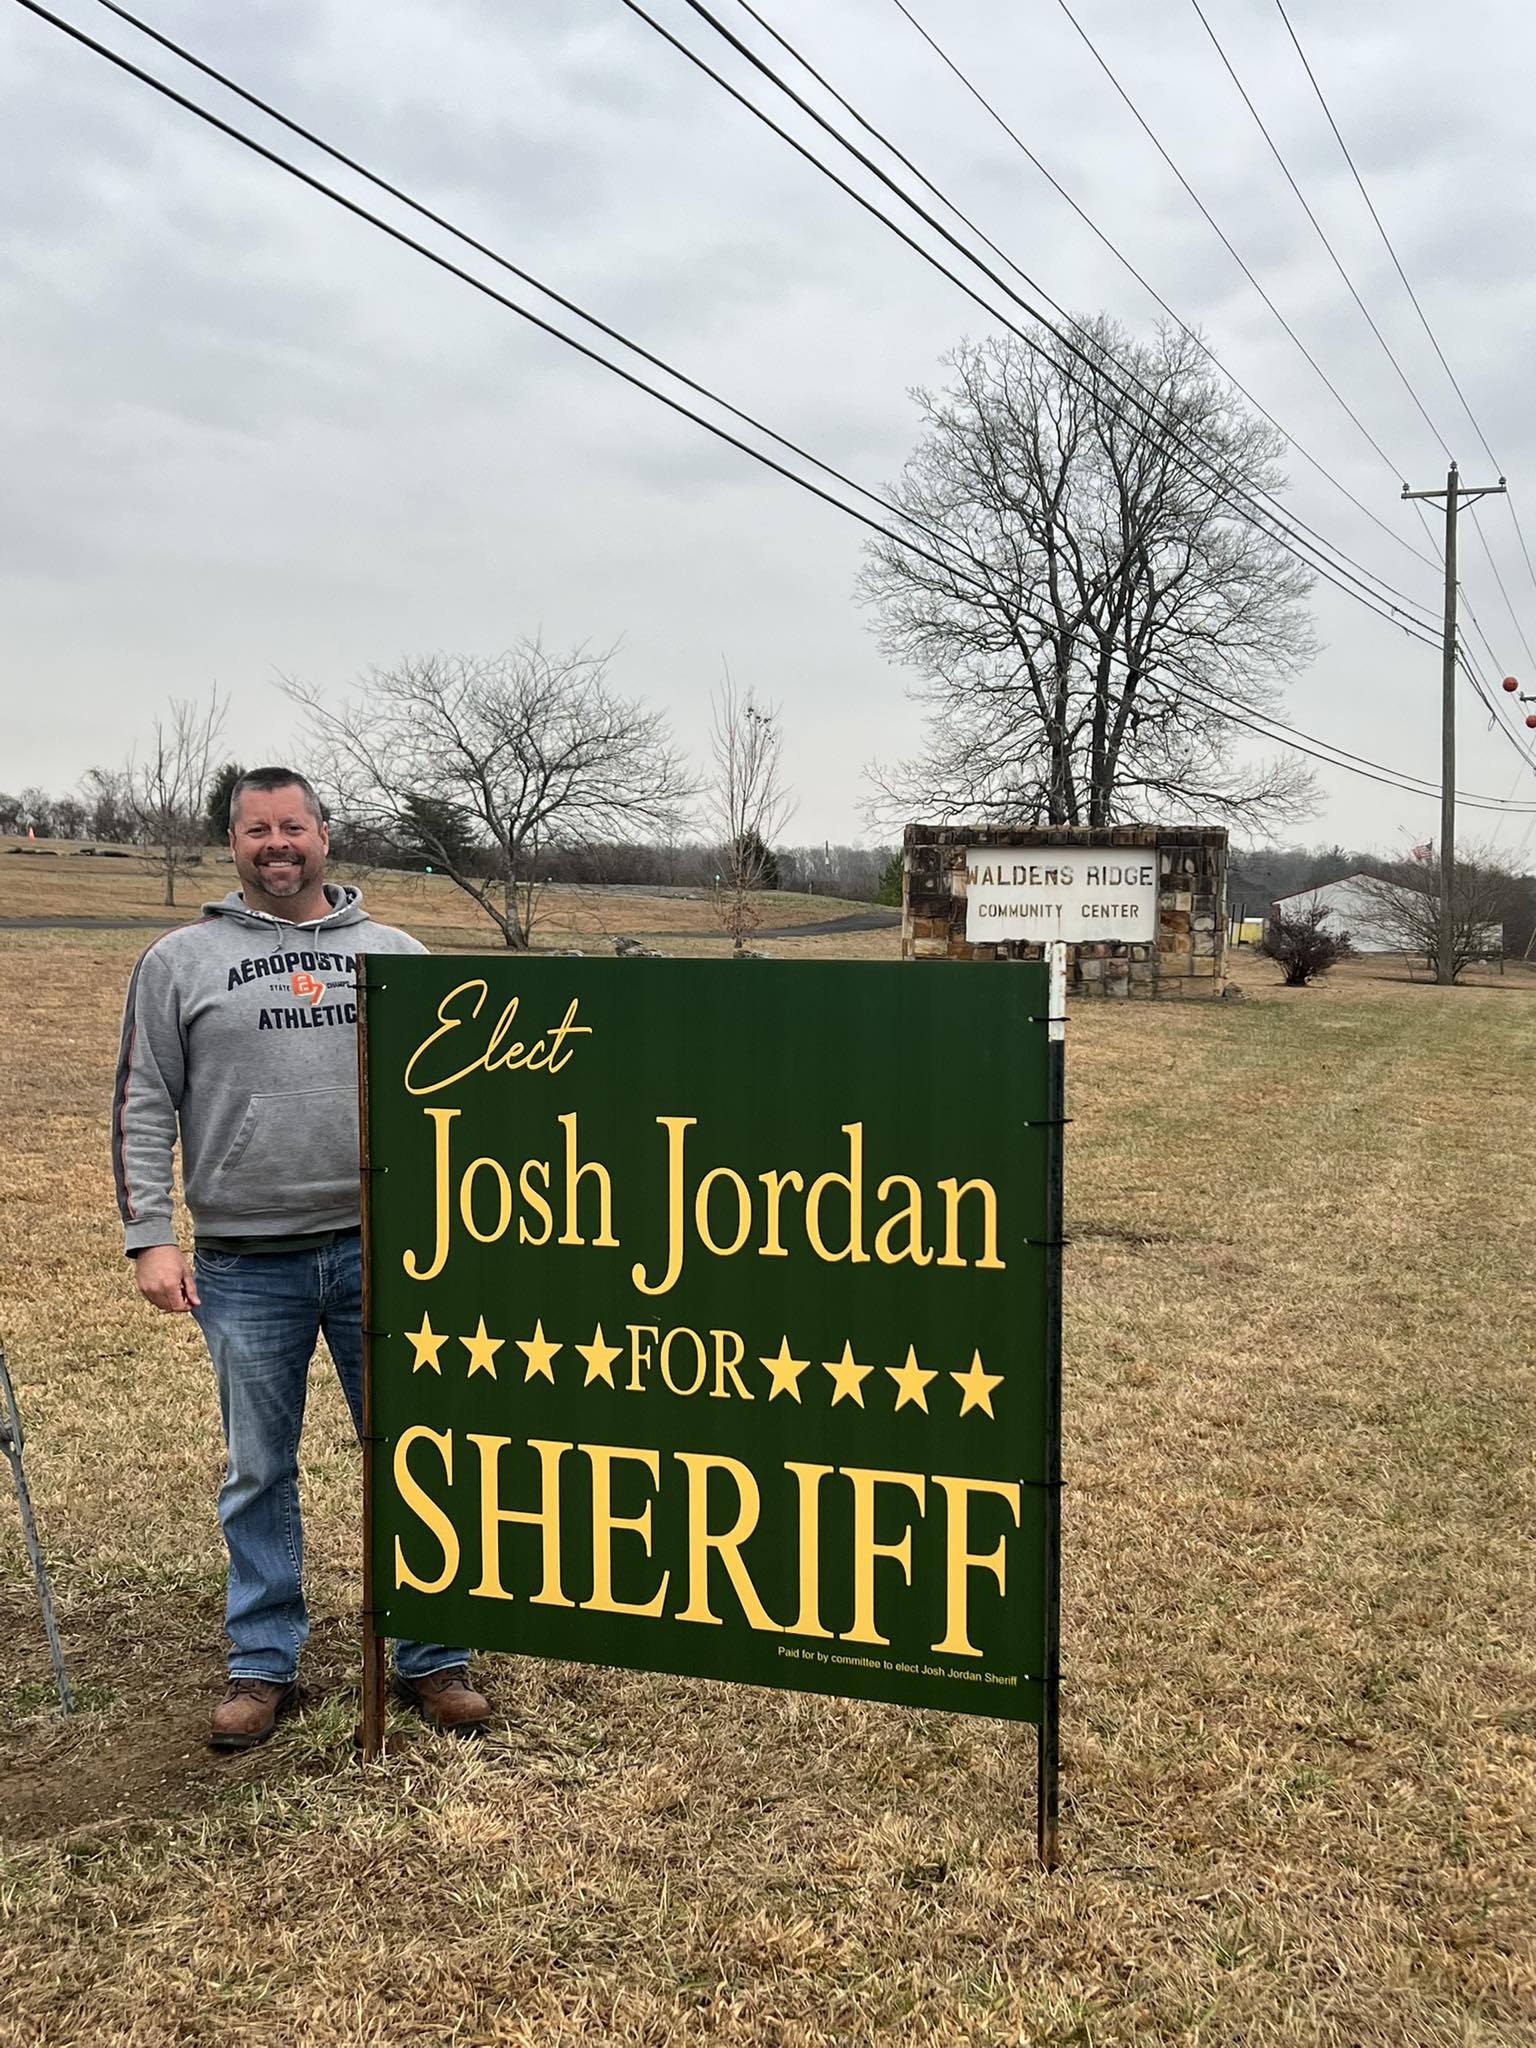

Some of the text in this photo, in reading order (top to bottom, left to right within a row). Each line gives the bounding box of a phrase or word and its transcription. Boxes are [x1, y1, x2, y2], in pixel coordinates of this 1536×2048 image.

[966, 865, 1154, 886] WALDENS RIDGE
[978, 904, 1139, 918] COMMUNITY CENTER
[269, 984, 291, 992] STATE
[405, 980, 593, 1094] Elect
[403, 1107, 1006, 1296] Josh Jordan
[625, 1324, 754, 1400] FOR
[393, 1425, 1021, 1657] SHERIFF
[778, 1646, 1018, 1686] Paid for by committee to elect Josh Jordan Sheriff
